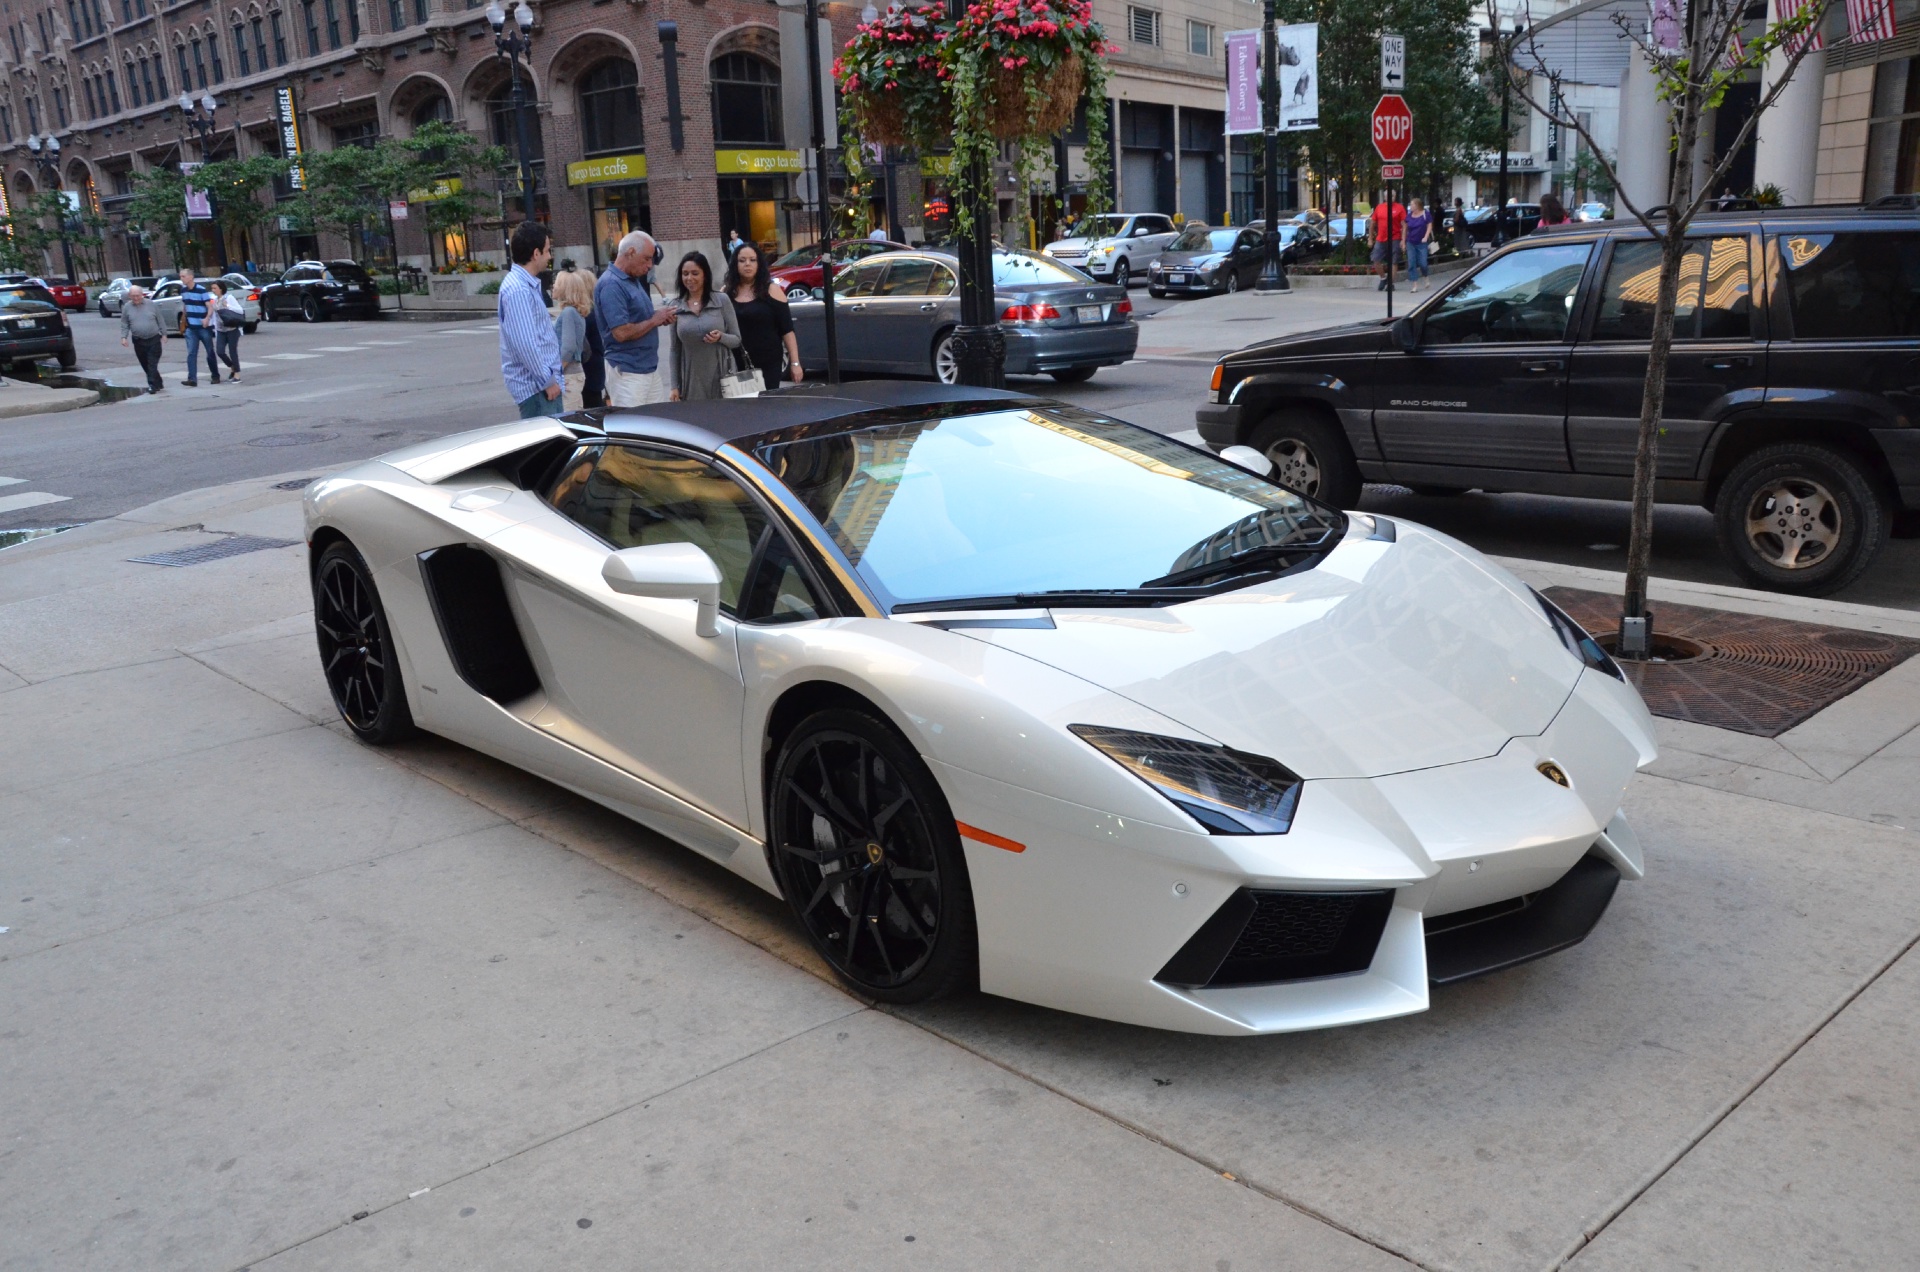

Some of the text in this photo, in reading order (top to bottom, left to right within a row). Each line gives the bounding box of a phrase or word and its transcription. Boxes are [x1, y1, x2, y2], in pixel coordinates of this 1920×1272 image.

[1384, 40, 1402, 53] ONE
[1238, 45, 1248, 81] Edward
[1384, 55, 1402, 67] WAY
[278, 89, 293, 122] BAGELS
[1236, 82, 1248, 112] Gorey
[1375, 115, 1410, 140] STOP
[1548, 124, 1556, 148] rack
[287, 150, 302, 189] EINSTN
[588, 165, 602, 178] tea
[603, 158, 628, 176] café
[754, 158, 776, 171] argo
[777, 156, 789, 168] tea
